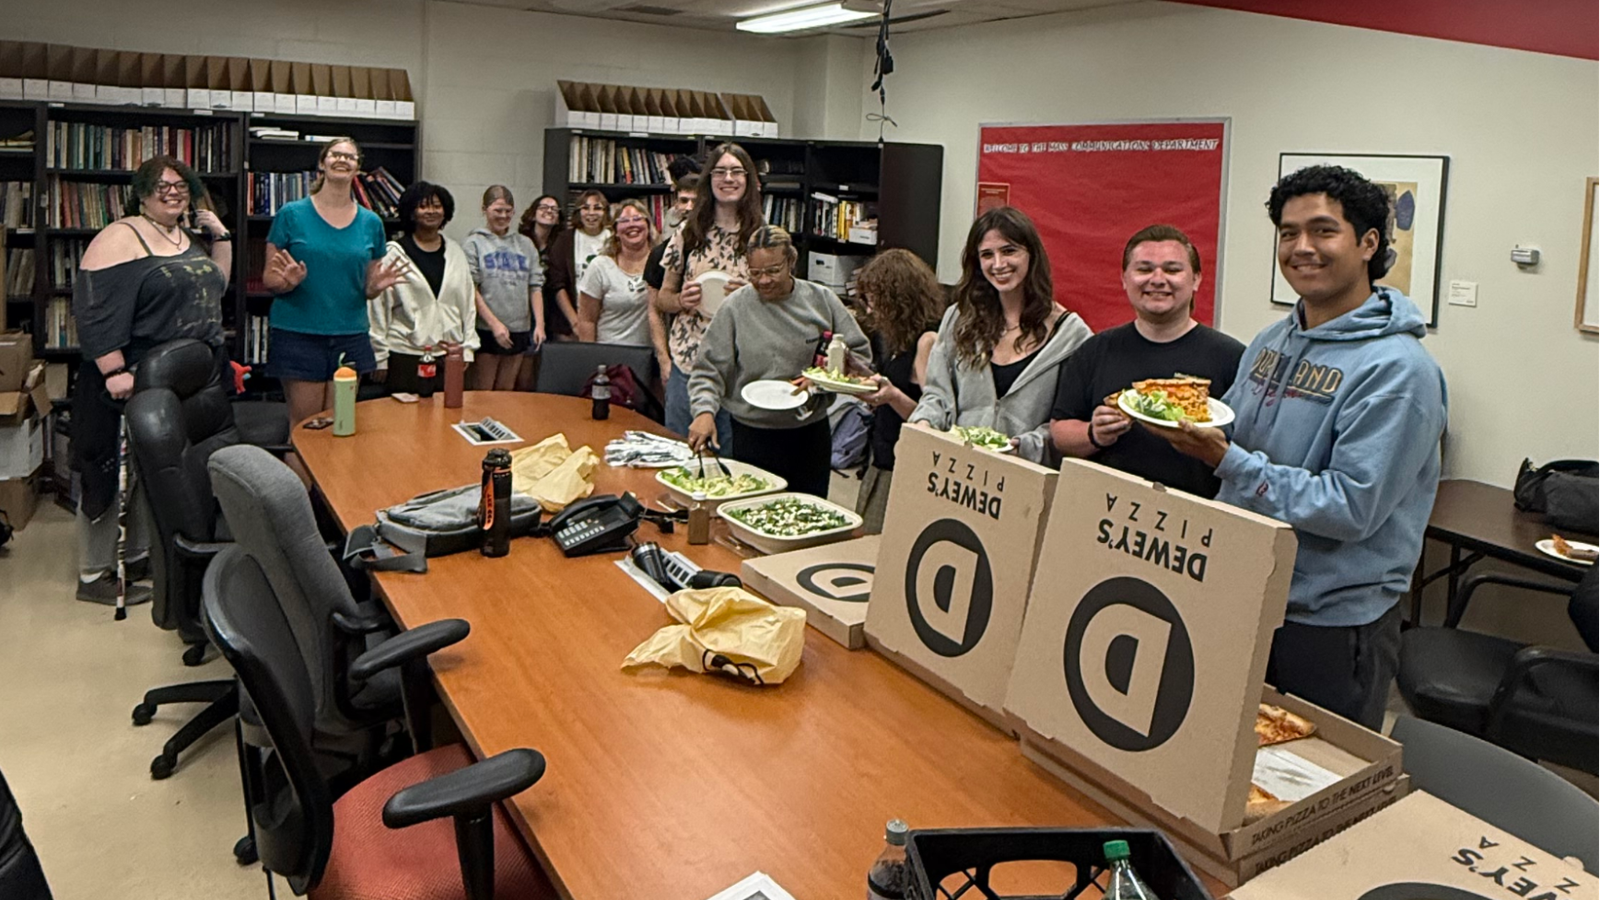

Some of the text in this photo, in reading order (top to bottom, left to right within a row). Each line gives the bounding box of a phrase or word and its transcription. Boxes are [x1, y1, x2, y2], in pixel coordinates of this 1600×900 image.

[1020, 144, 1029, 153] TO
[1032, 143, 1046, 152] THE
[1048, 142, 1069, 152] MASS
[1152, 138, 1219, 151] DEPARTMENT
[927, 472, 1002, 520] DEWEY'S
[933, 451, 1004, 492] PIZZA
[1106, 493, 1213, 548] PIZZA
[1097, 519, 1207, 582] DEWEY'S
[1252, 766, 1394, 845] TAKING PIZZA TO THE NEXT LEVEL
